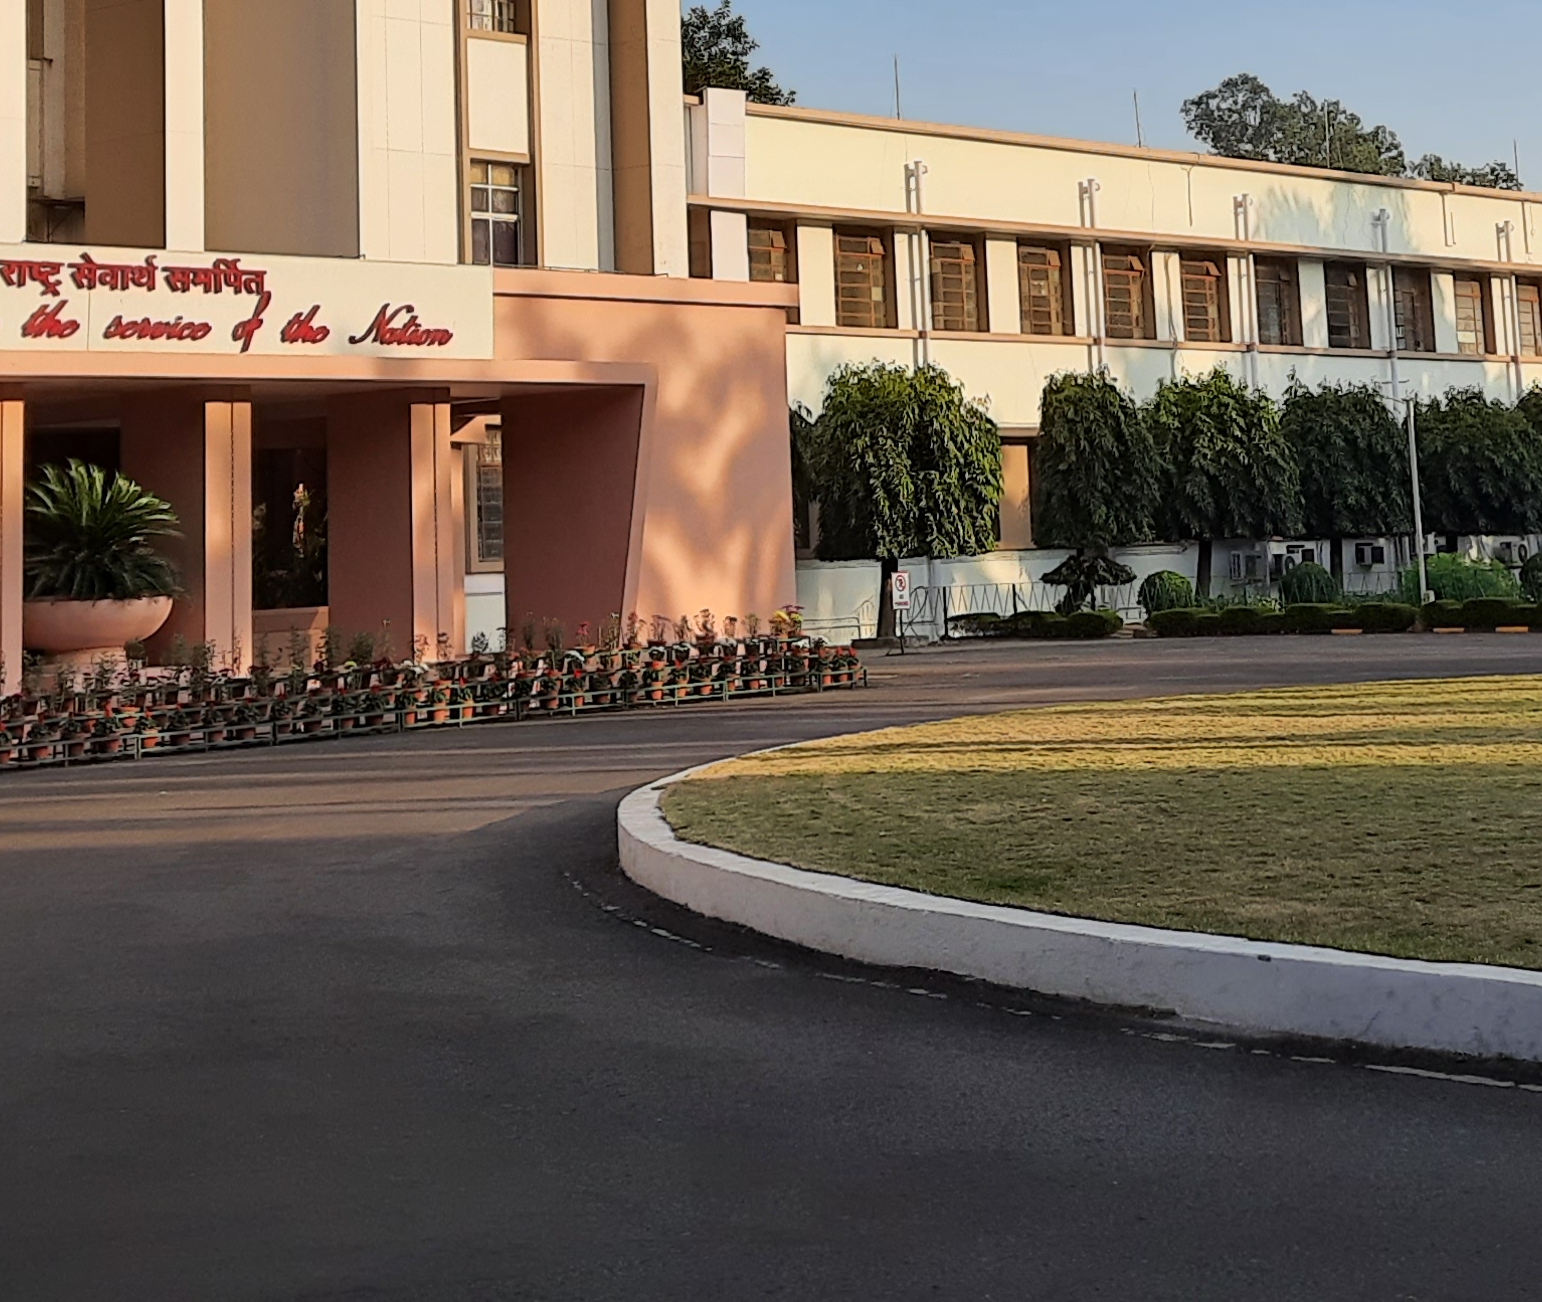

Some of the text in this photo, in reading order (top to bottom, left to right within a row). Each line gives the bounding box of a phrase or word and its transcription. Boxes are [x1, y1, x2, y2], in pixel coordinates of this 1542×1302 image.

[67, 252, 158, 292] सेवार्थ
[161, 258, 267, 296] समर्पित
[21, 299, 81, 339] the
[103, 315, 213, 341] service
[231, 290, 272, 354] of
[280, 304, 330, 344] the
[348, 303, 454, 346] Nation
